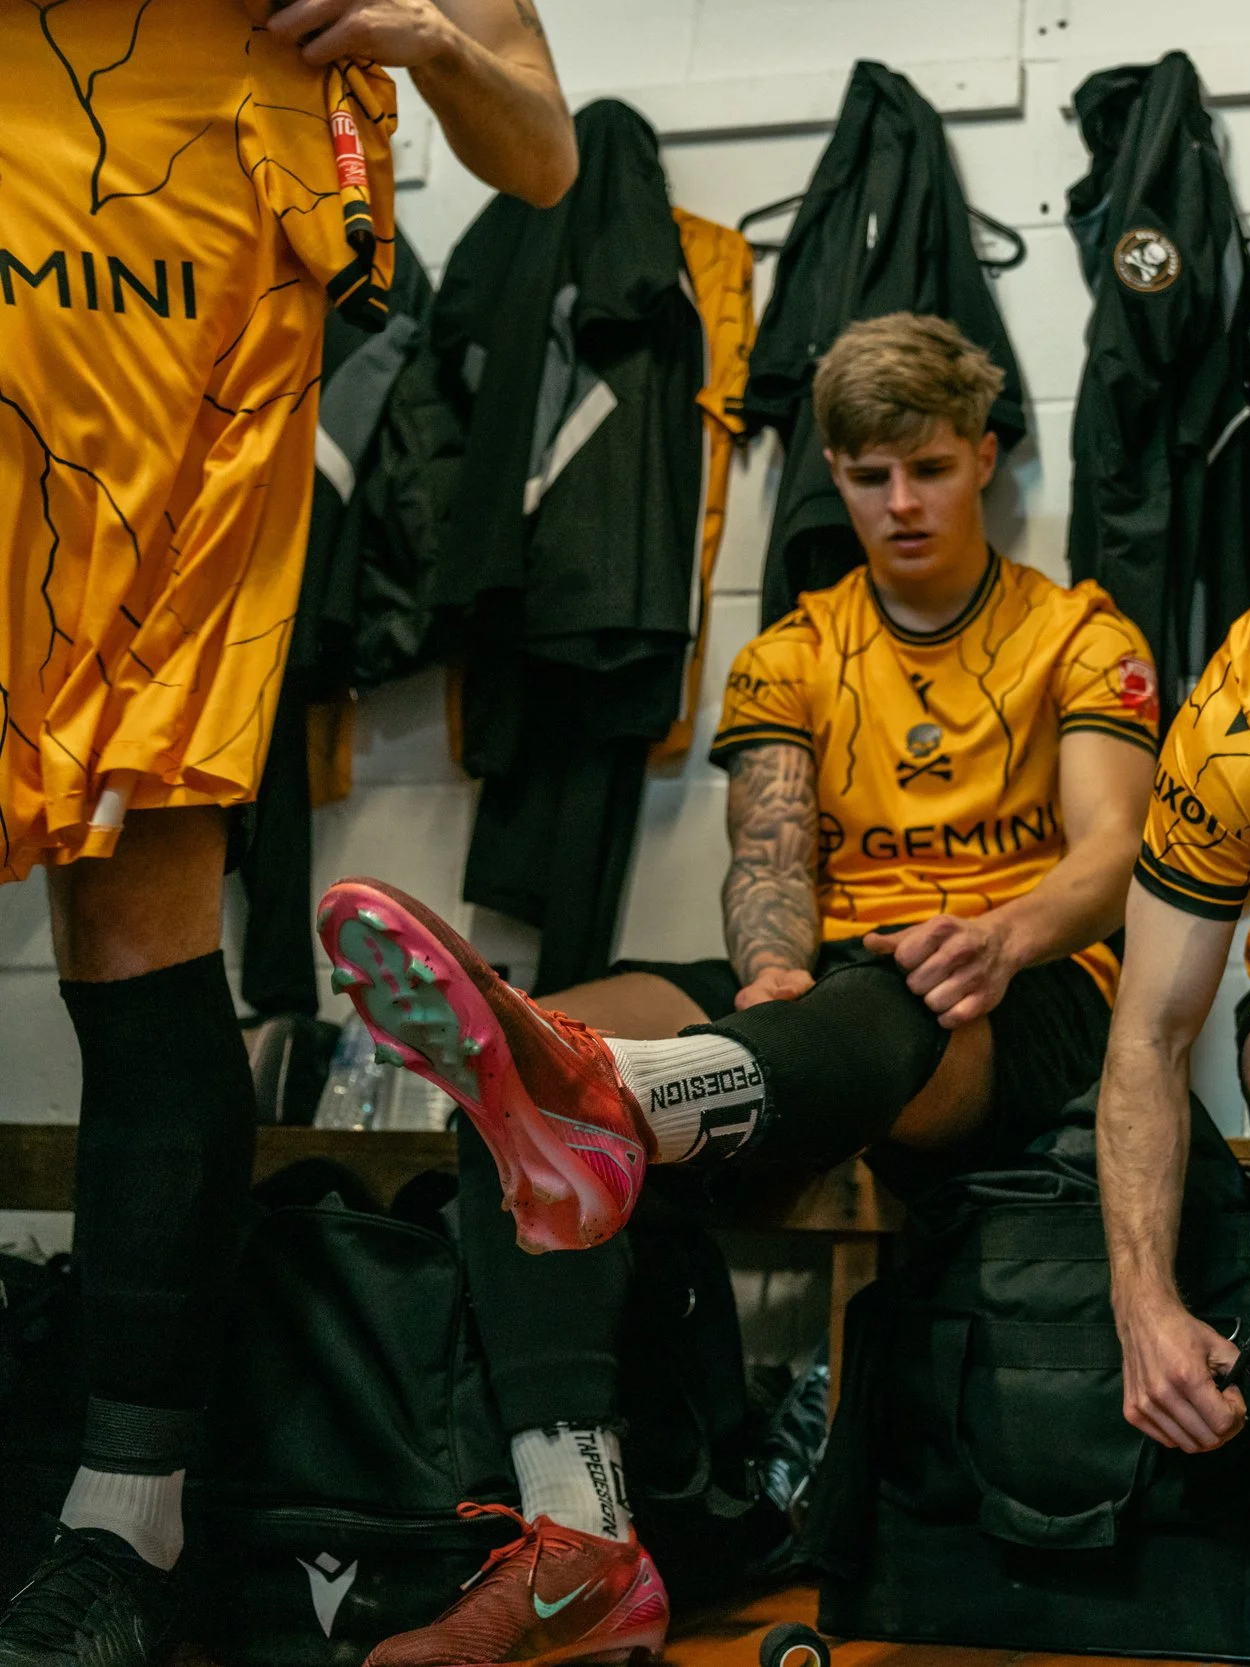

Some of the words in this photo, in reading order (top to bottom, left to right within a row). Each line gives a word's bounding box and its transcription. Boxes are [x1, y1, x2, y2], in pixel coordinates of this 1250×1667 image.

[0, 248, 197, 319] MINI
[861, 801, 1058, 860] GEMINI
[574, 1432, 618, 1539] TAPEDESIGN
